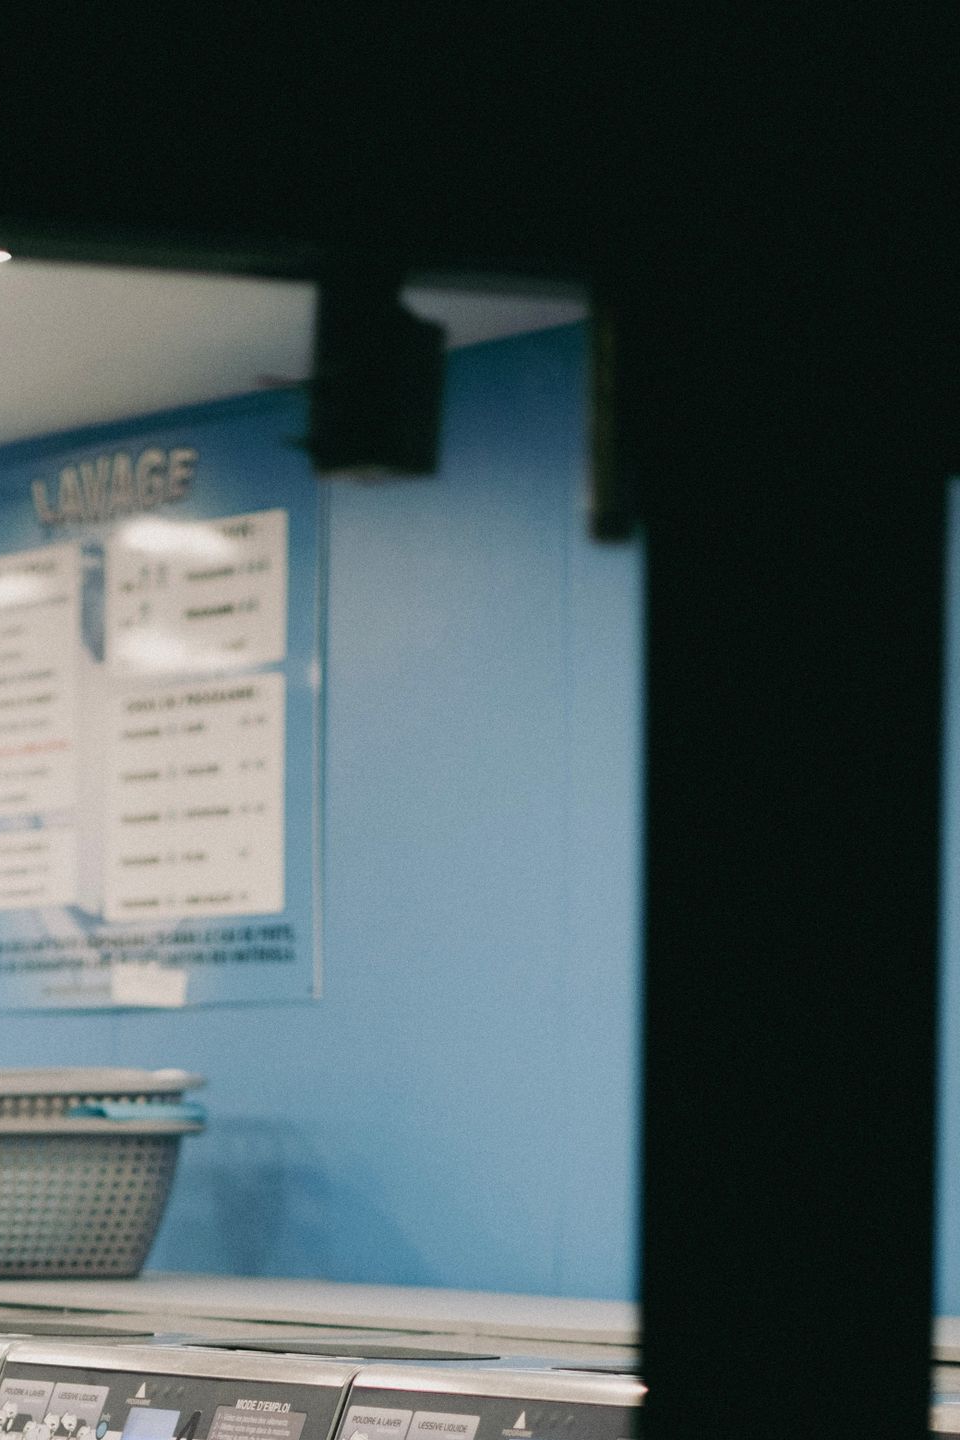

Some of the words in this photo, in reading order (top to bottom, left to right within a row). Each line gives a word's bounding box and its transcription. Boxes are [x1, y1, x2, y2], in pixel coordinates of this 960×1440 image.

[31, 448, 198, 522] LAVAGE
[235, 1399, 258, 1411] MODE
[257, 1400, 291, 1414] D'EMPLOI
[352, 1415, 377, 1425] POUDRE
[382, 1418, 402, 1427] LAVER
[418, 1421, 443, 1431] LESSIVE
[443, 1423, 469, 1433] LIQUIDE
